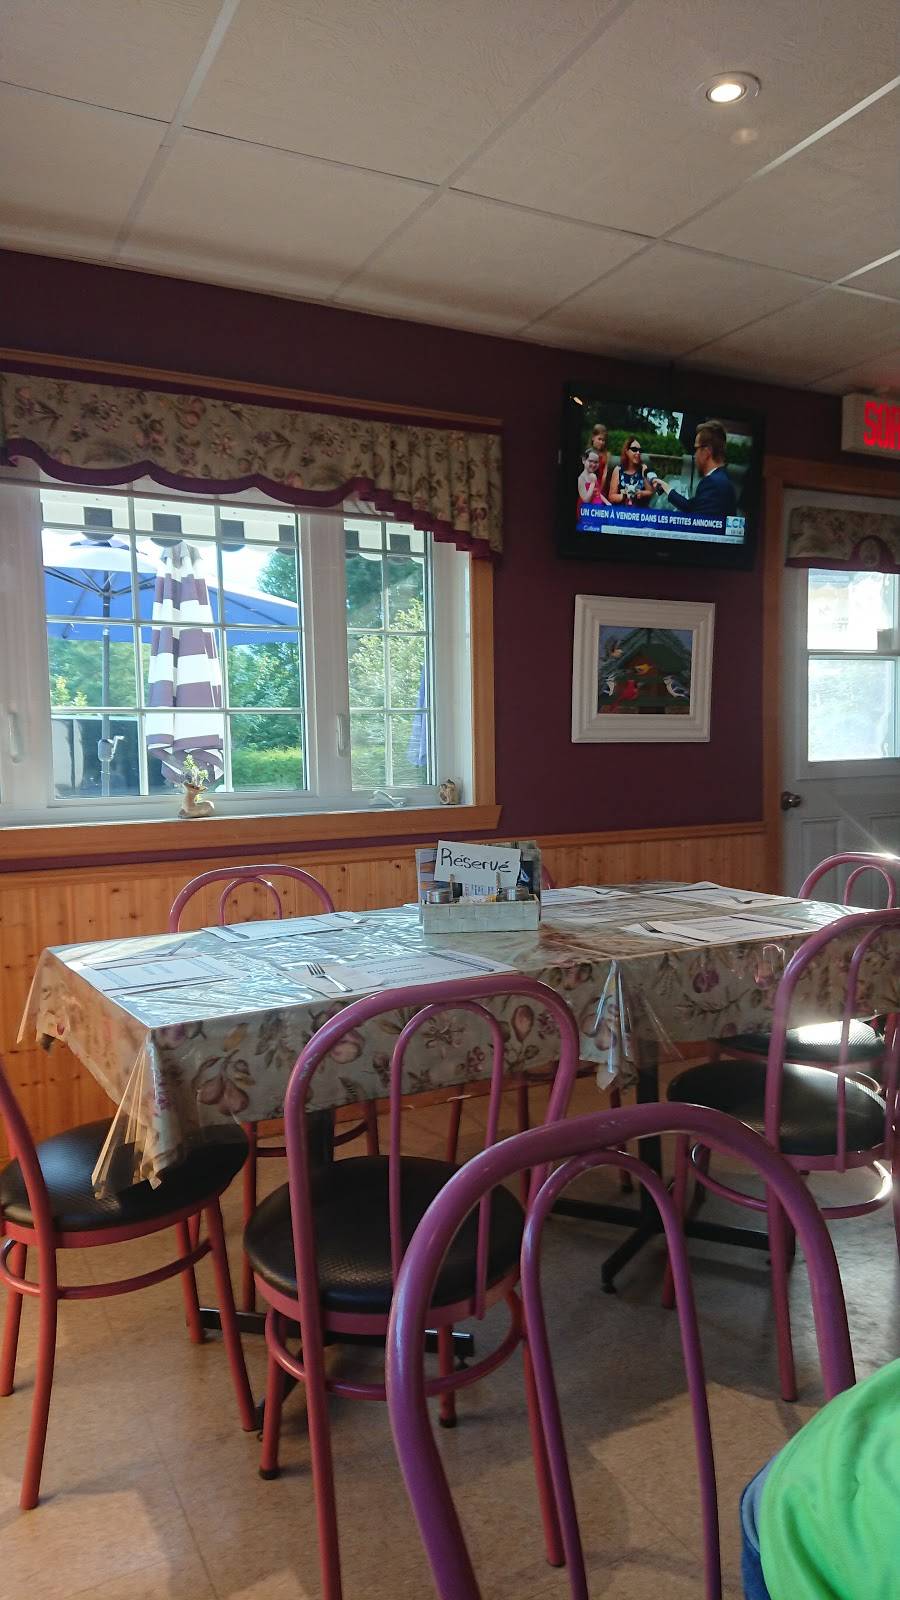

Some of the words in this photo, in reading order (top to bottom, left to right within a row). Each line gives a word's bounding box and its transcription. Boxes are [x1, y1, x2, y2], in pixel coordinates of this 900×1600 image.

[580, 508, 590, 516] UN
[591, 509, 610, 519] CHIEN
[610, 509, 615, 519] À
[616, 511, 640, 521] VENDRE
[640, 514, 657, 523] DANS
[657, 515, 669, 524] LES
[669, 516, 691, 526] PETITES
[692, 518, 723, 529] ANNONCES
[441, 848, 512, 872] Réservé
